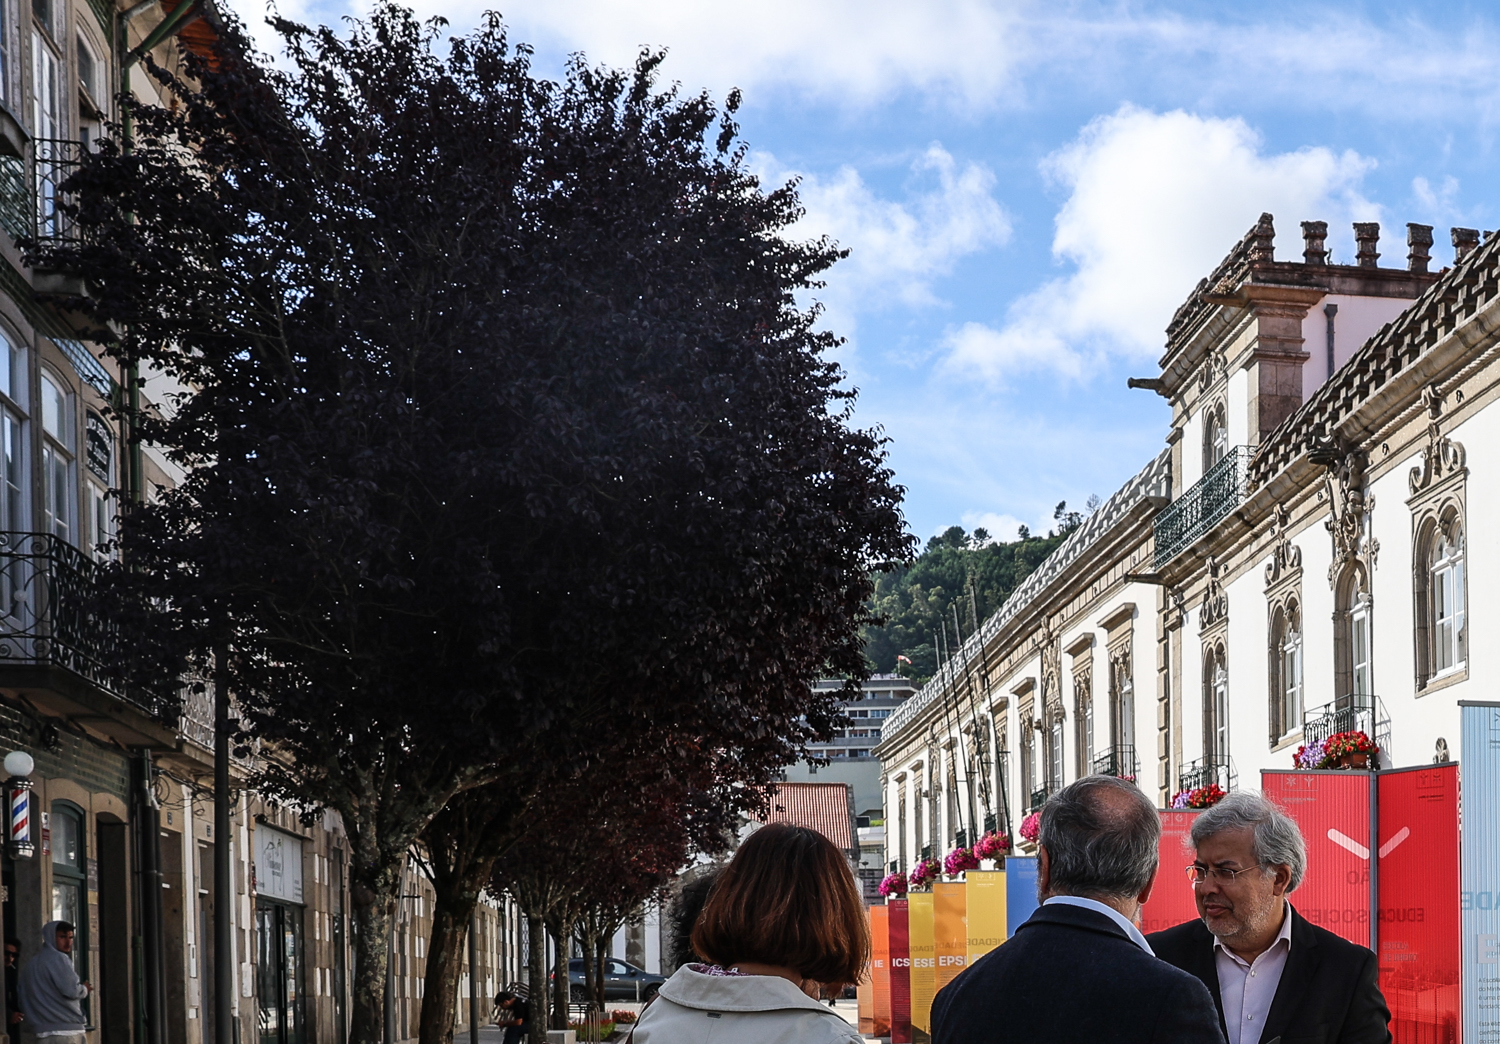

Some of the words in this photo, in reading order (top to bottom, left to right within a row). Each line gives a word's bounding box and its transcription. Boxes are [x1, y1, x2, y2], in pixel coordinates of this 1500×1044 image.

[892, 958, 910, 967] ICS
[913, 958, 935, 968] ESE
[938, 955, 967, 967] EPSI
